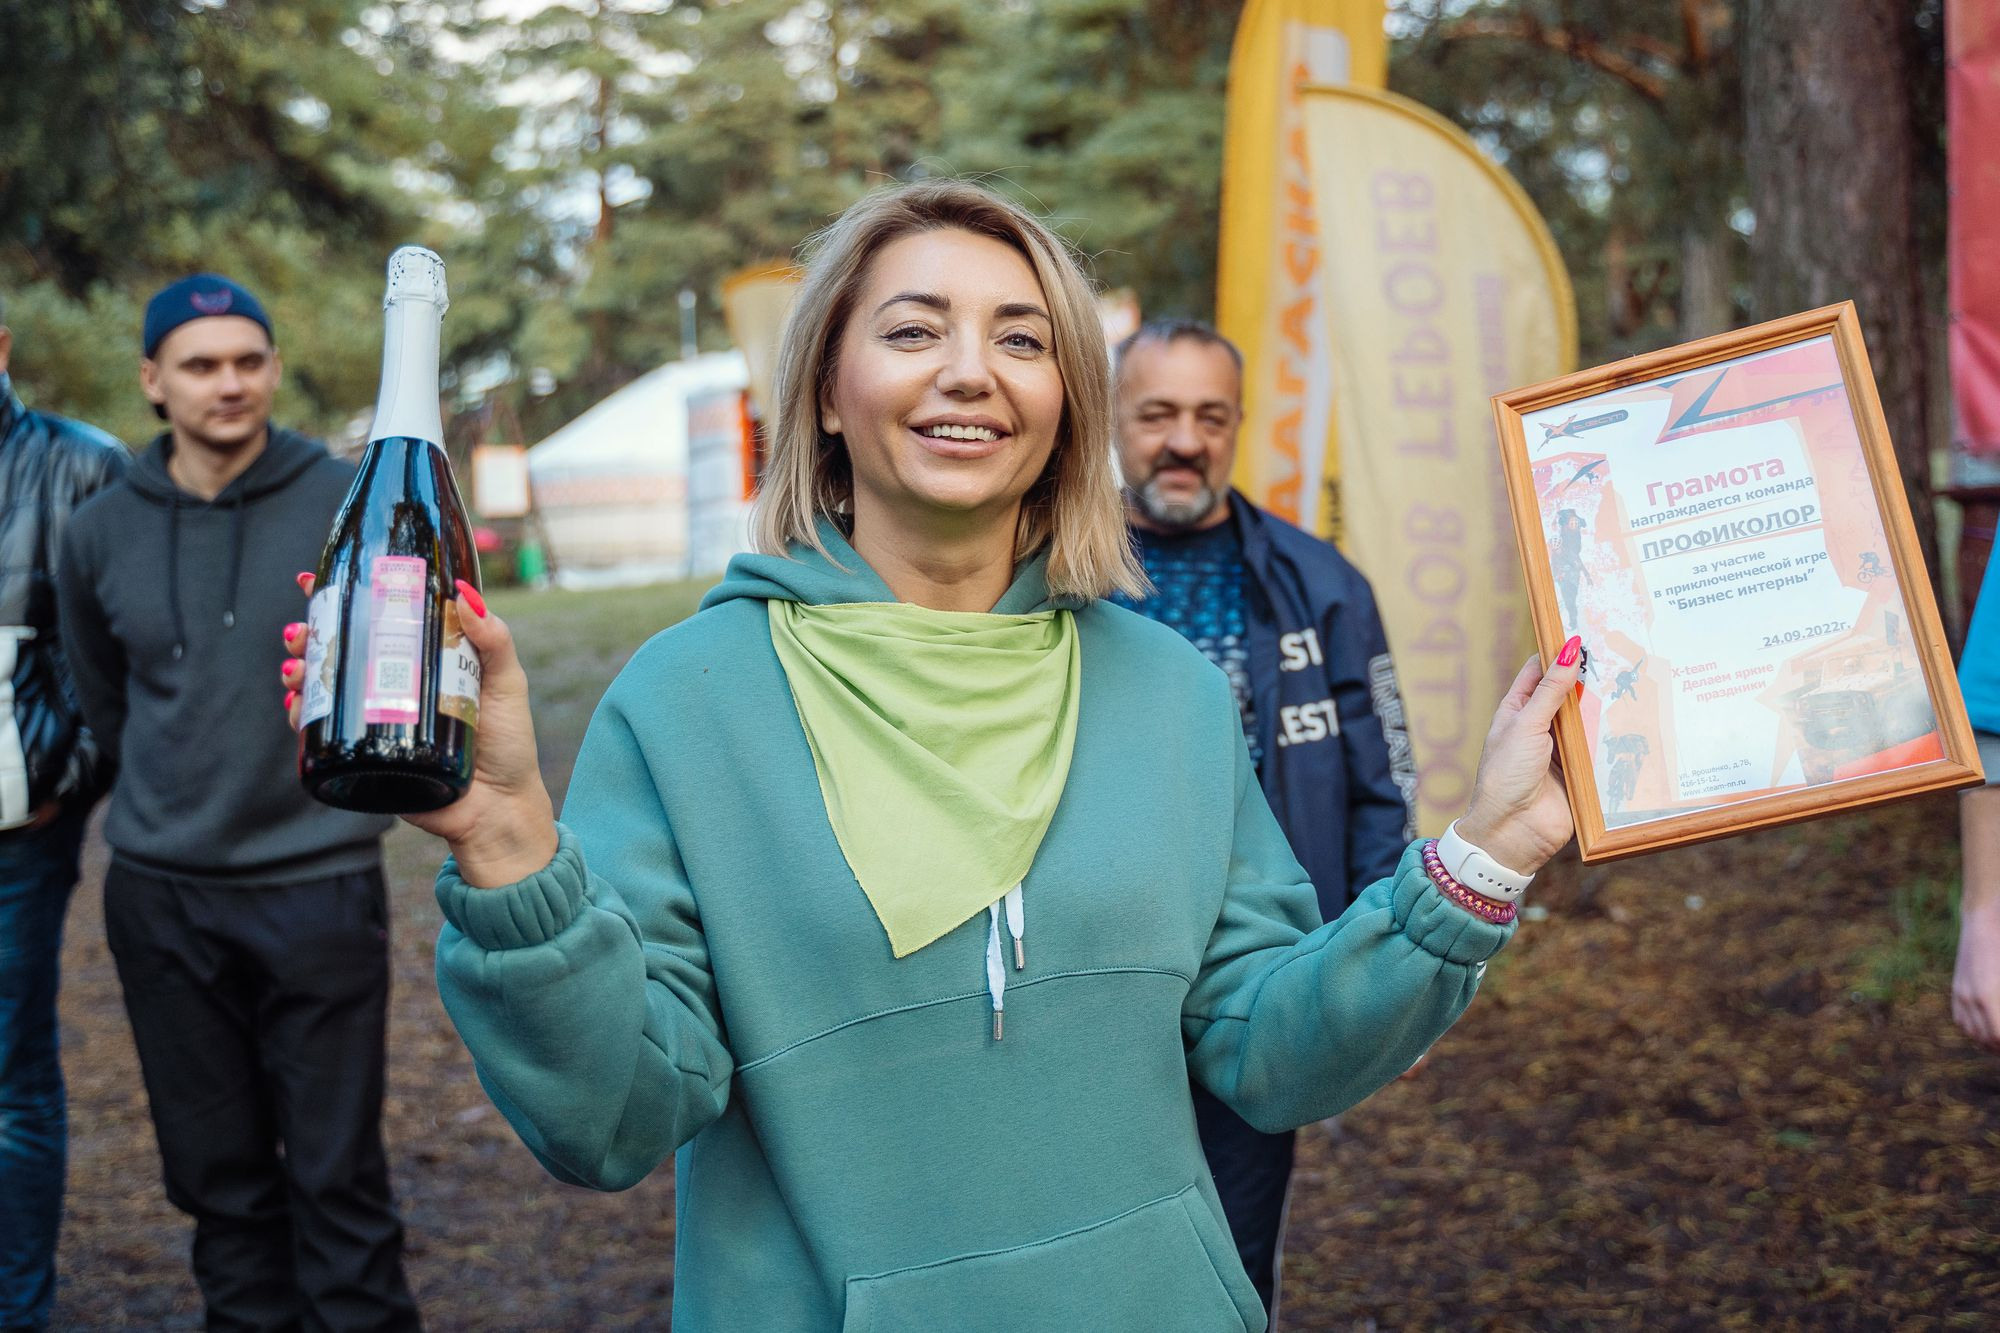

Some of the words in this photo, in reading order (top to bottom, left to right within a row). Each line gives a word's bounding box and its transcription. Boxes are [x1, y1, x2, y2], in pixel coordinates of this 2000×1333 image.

[1630, 493, 1742, 529] награждается
[1745, 476, 1815, 501] команда
[1645, 456, 1786, 507] Грамота
[1642, 504, 1816, 560] ПРОФИКОЛОР
[1653, 589, 1662, 599] в
[1665, 557, 1793, 596] приключенческой
[1794, 550, 1828, 567] игре
[1691, 563, 1708, 575] за
[1710, 549, 1767, 573] участие
[1668, 588, 1735, 611] “Бизнес
[1736, 567, 1816, 596] интерны”
[1280, 627, 1324, 672] ST
[1762, 619, 1852, 648] 24.09.2022г.
[1671, 661, 1718, 678] X-team
[1682, 673, 1732, 692] Делаем
[1734, 663, 1775, 681] яркие
[1696, 680, 1767, 703] праздники
[1278, 698, 1341, 747] EST
